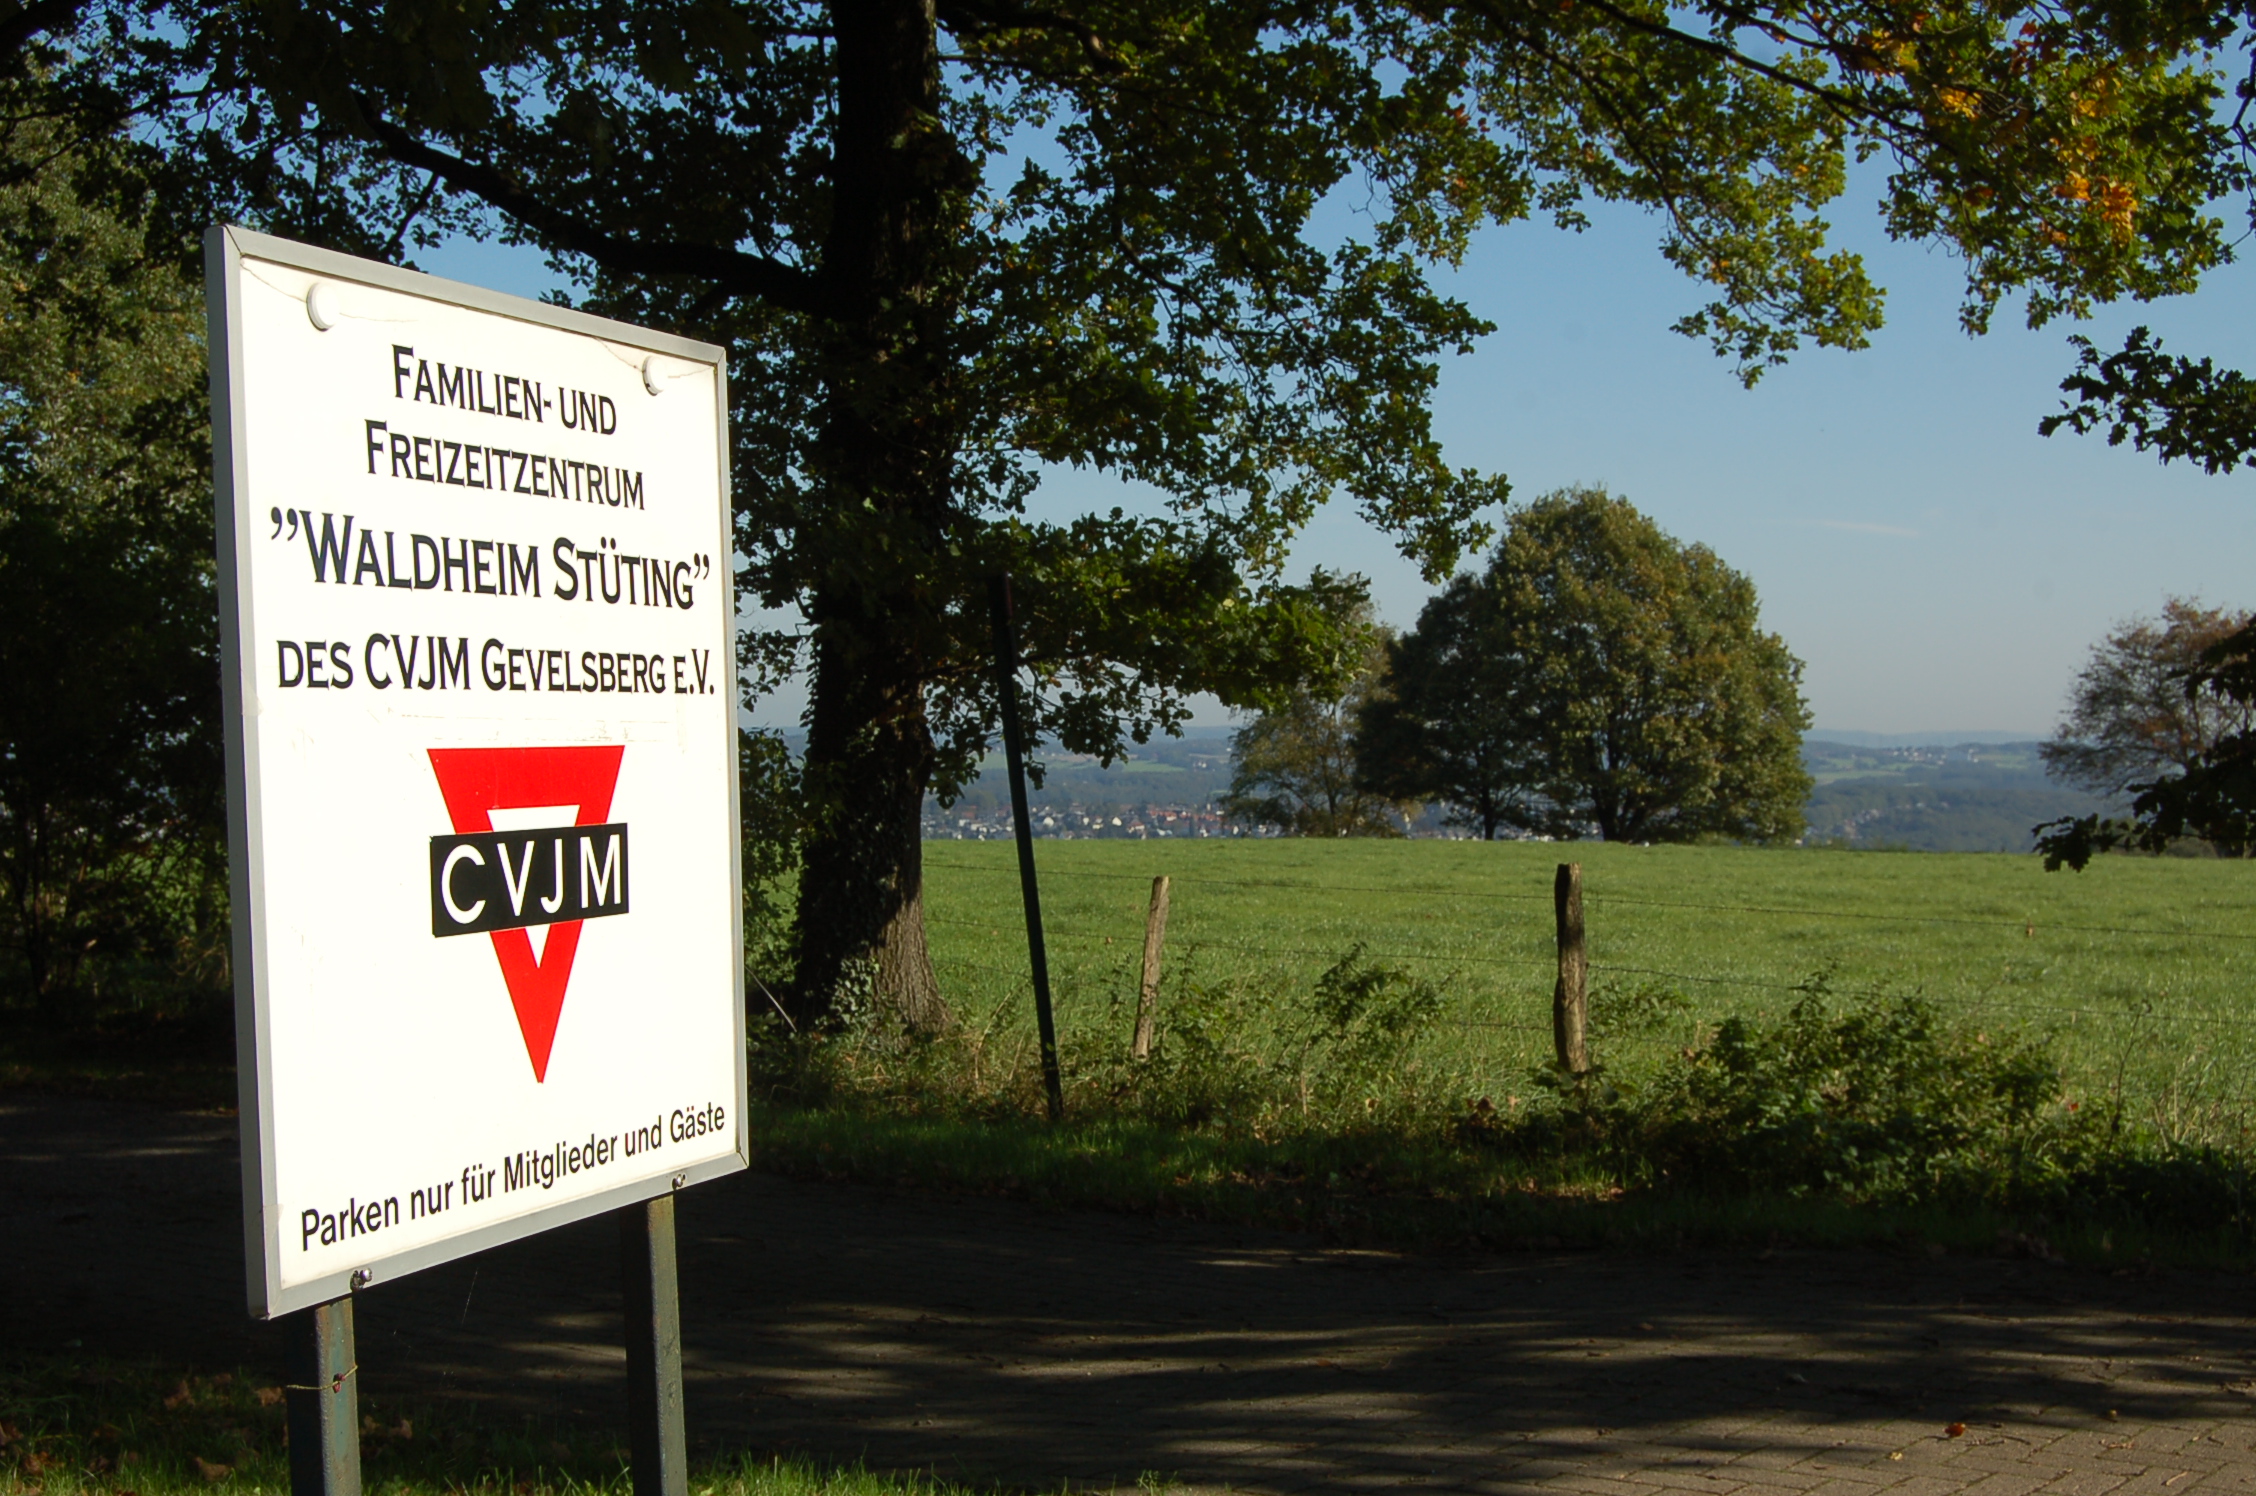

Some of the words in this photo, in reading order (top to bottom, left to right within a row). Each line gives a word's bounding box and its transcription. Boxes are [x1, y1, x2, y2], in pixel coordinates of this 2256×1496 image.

[558, 387, 617, 435] UND
[364, 419, 645, 510] FREIZEITZENTRUM
[277, 640, 354, 690] DES
[365, 632, 471, 691] CVJM
[481, 637, 666, 694] GEVELSBERG
[441, 833, 622, 925] CVJM
[302, 1197, 399, 1252] Parken
[410, 1181, 454, 1220] nur
[461, 1163, 496, 1205] für
[504, 1134, 618, 1193] Mitglieder
[624, 1115, 662, 1157] und
[670, 1102, 725, 1143] Gäste
